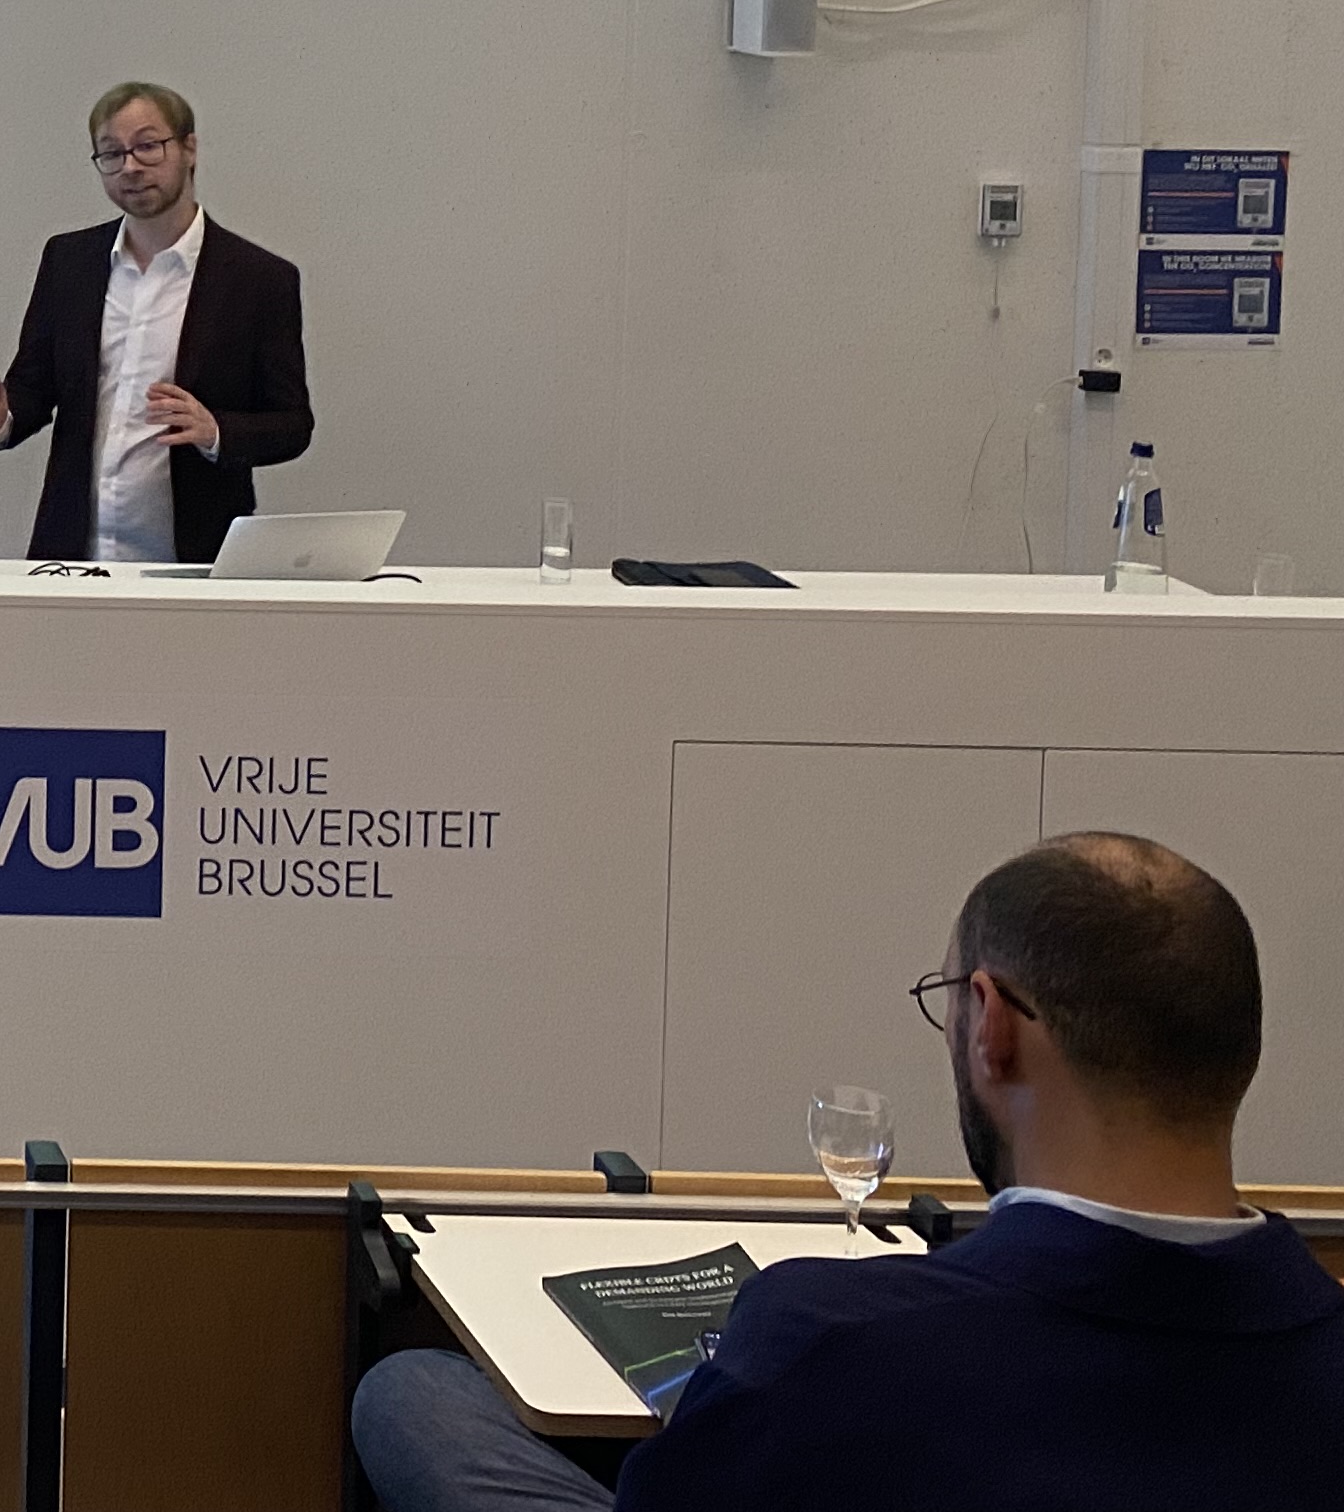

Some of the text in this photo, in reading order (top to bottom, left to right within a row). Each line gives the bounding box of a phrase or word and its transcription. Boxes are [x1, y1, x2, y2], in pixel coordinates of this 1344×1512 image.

[198, 754, 329, 796] VRIJE
[198, 806, 501, 849] UNIVERSITEIT
[197, 857, 394, 899] BRUSSEL
